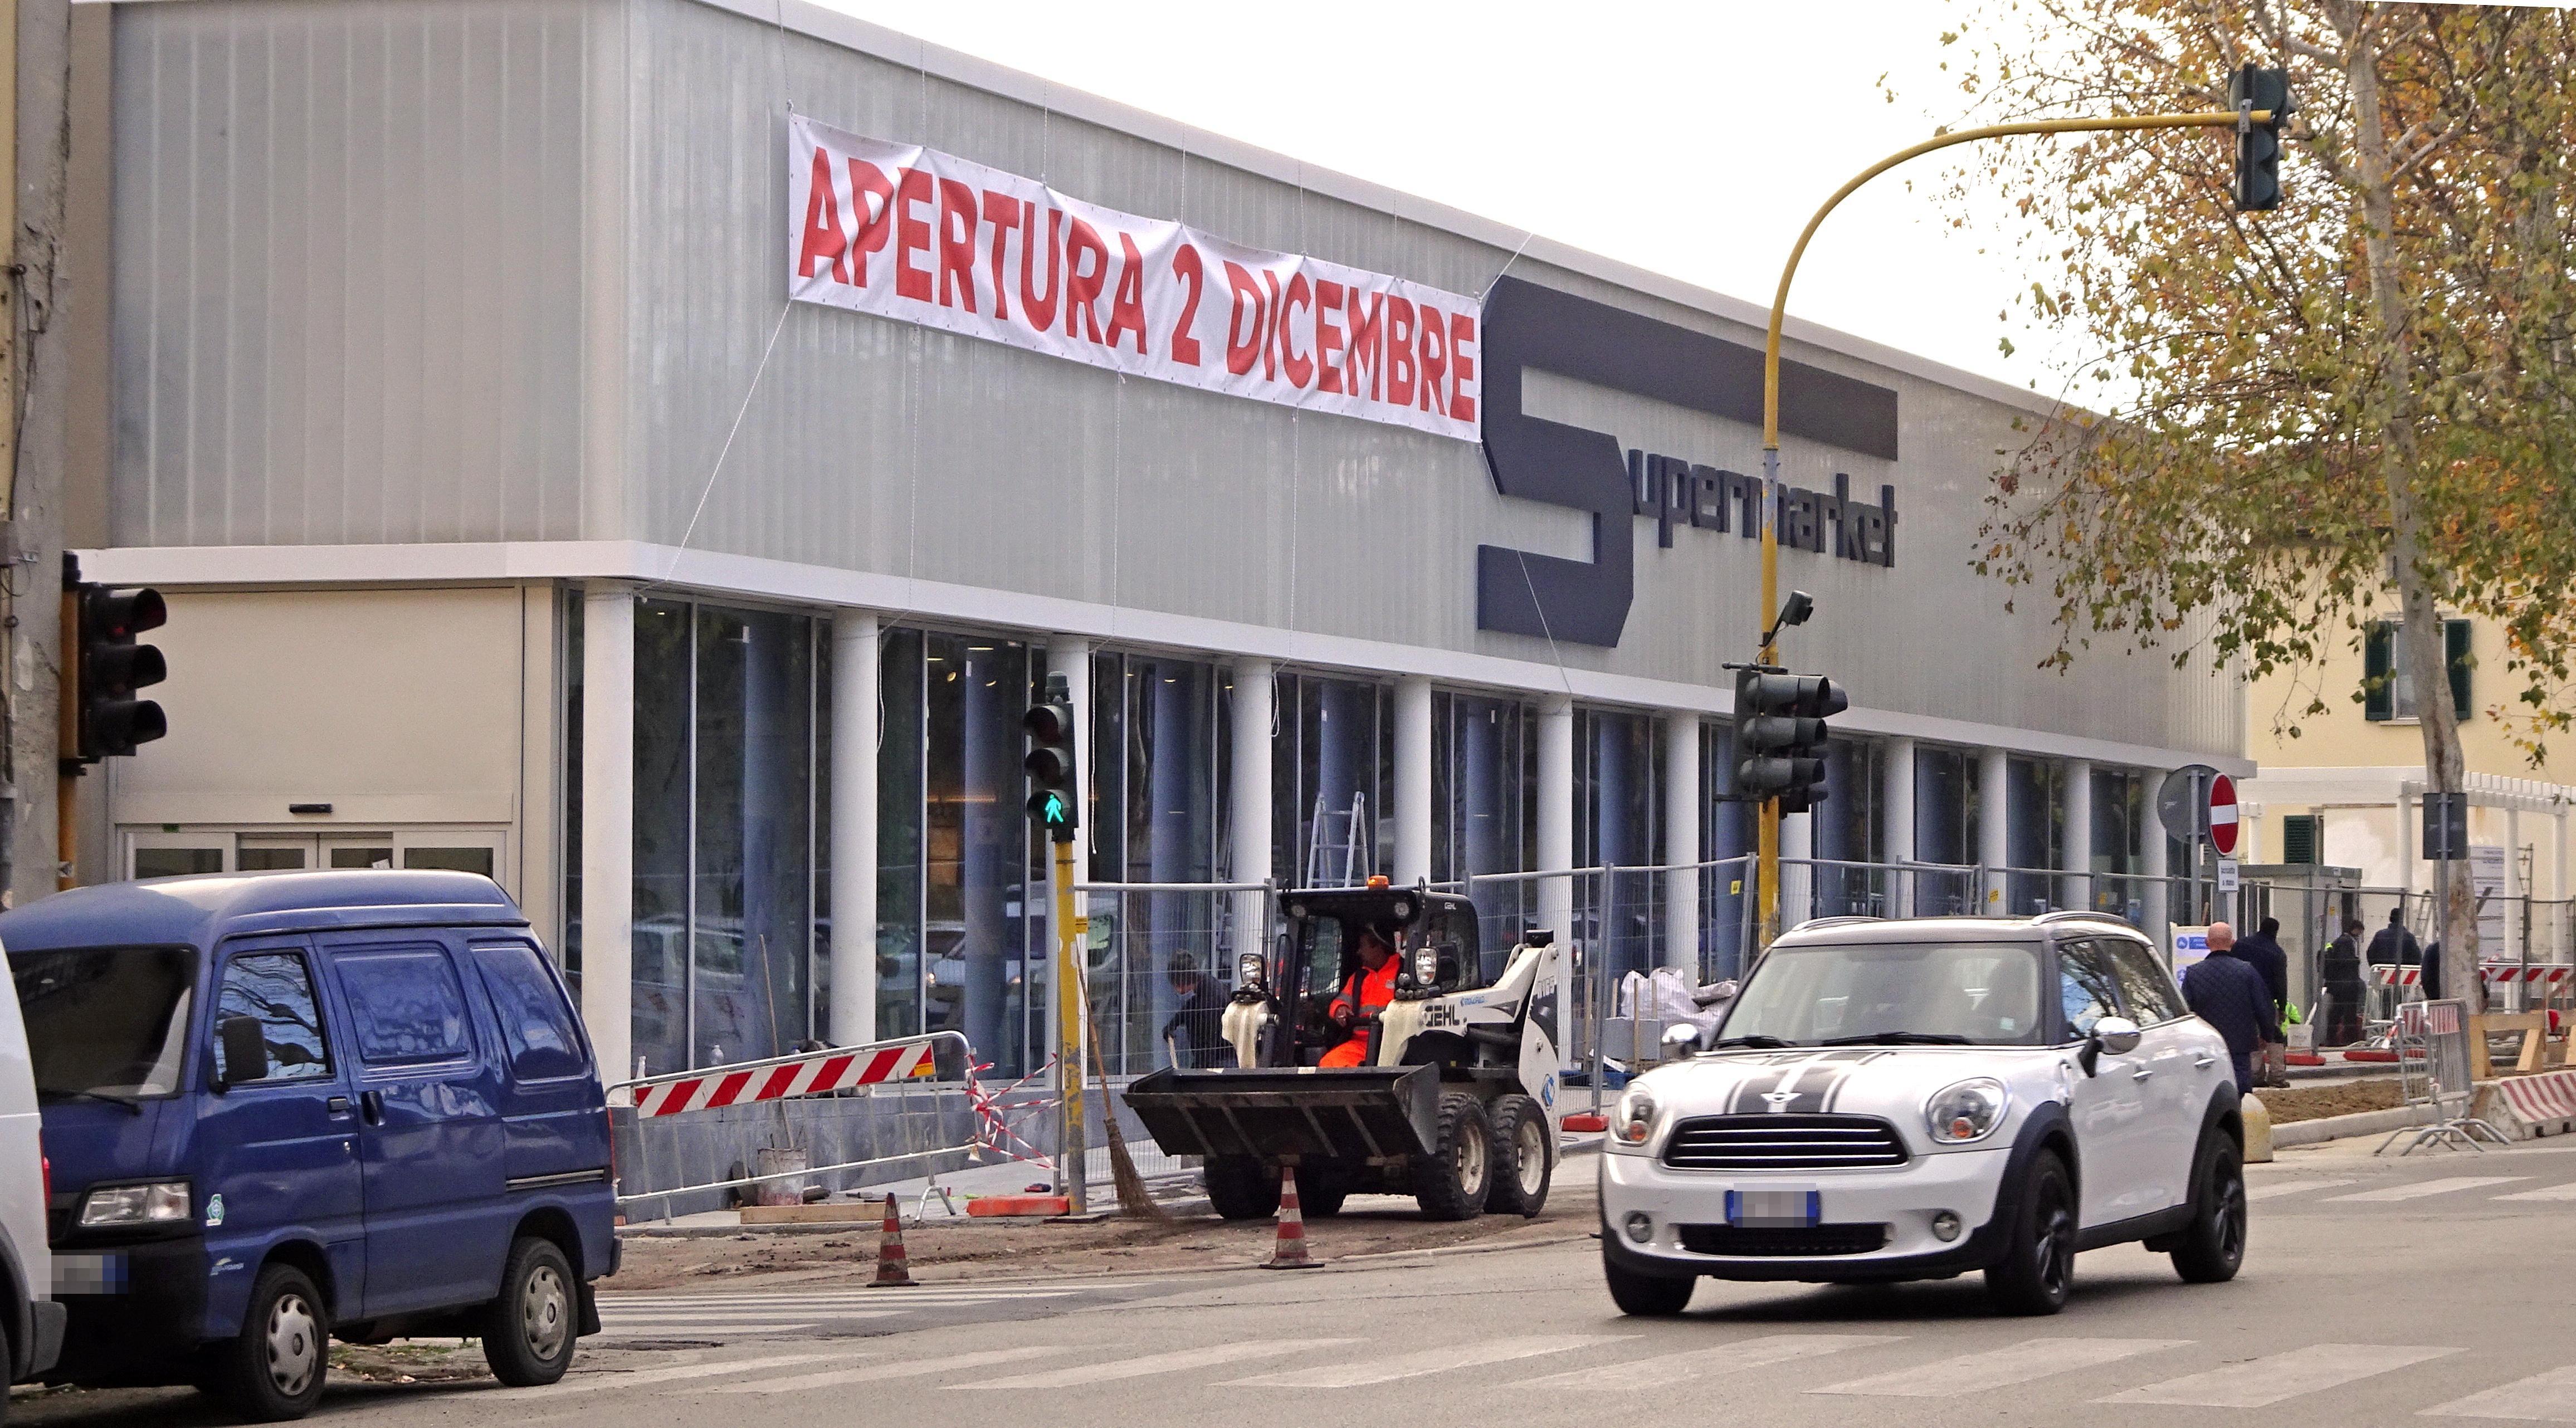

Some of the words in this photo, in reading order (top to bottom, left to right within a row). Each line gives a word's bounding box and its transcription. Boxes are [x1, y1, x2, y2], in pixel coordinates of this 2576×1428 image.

[798, 146, 1148, 355] APERTURA
[1172, 243, 1203, 367] 2
[1223, 260, 1475, 423] DICEMBRE
[1478, 275, 1899, 648] Supermarket
